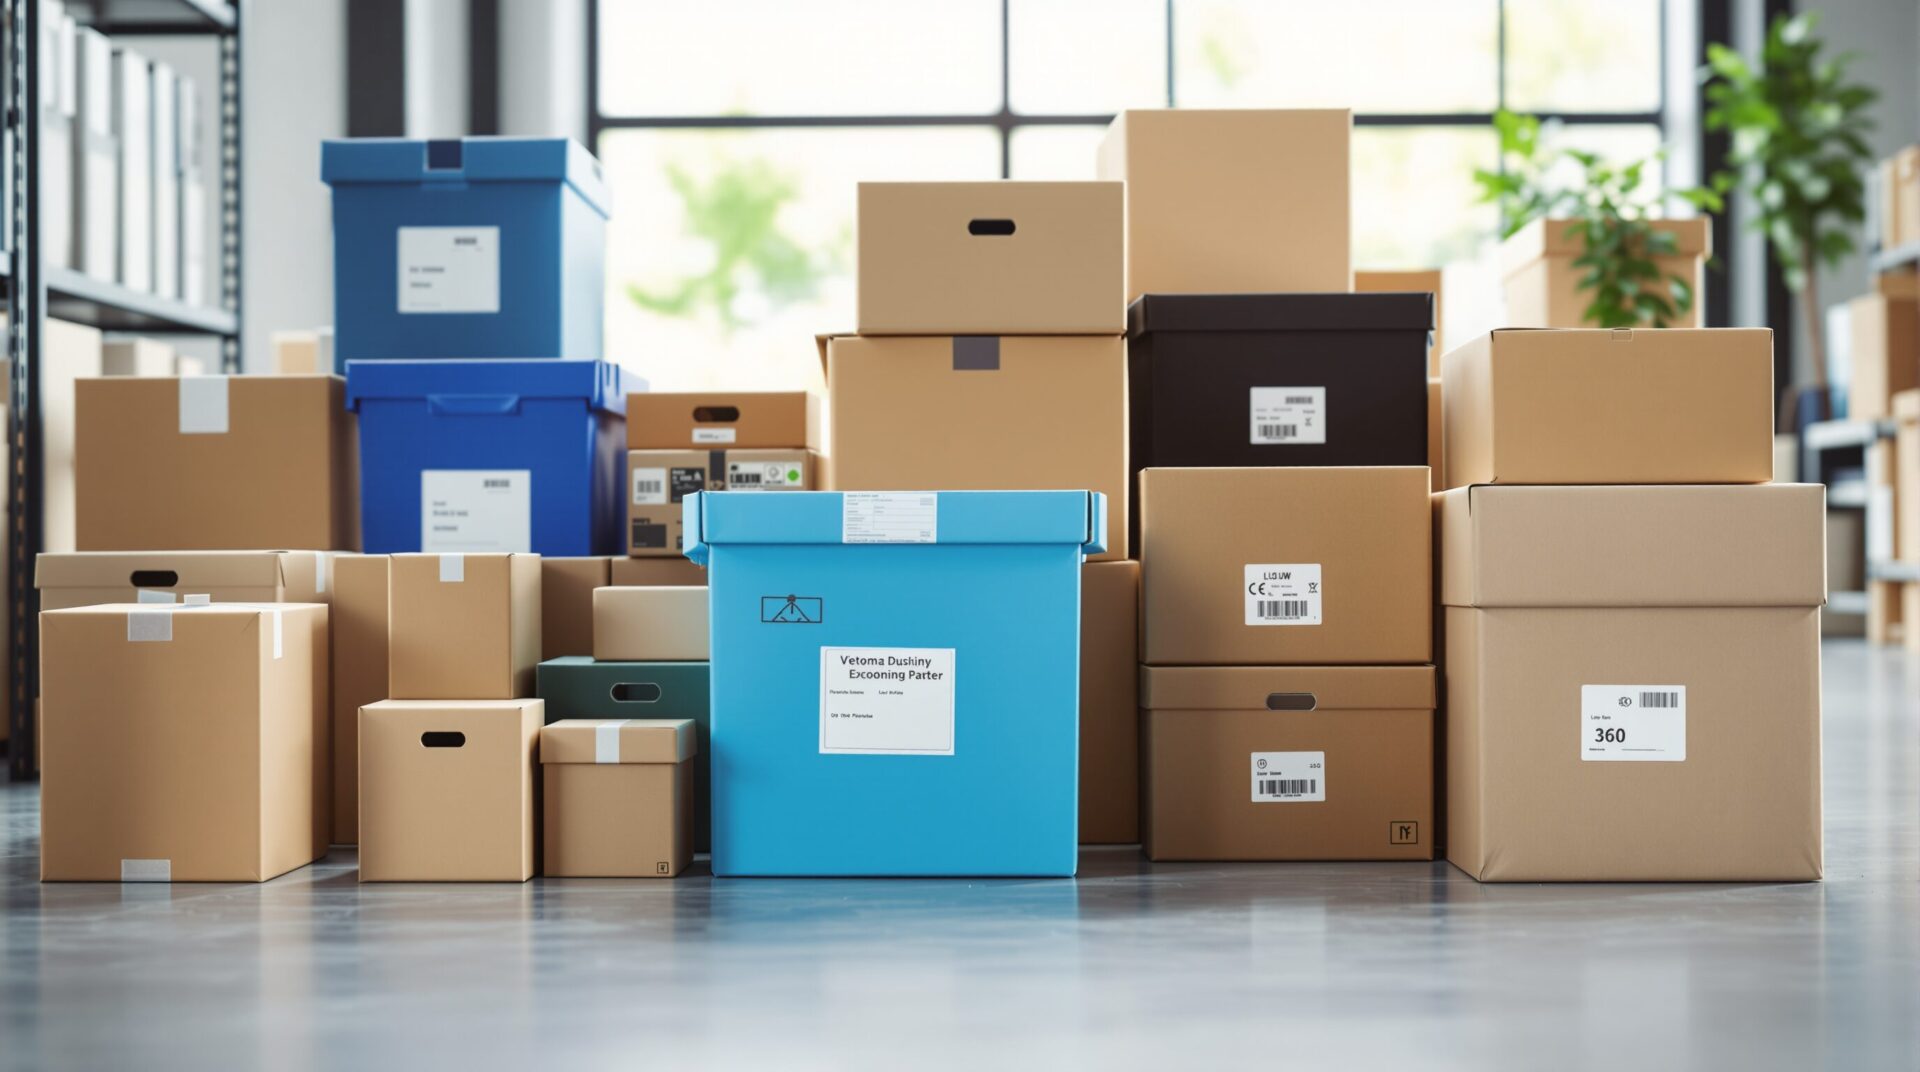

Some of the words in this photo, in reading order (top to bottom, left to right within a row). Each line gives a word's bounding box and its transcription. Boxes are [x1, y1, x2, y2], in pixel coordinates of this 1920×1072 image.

[840, 655, 885, 666] Vetoma
[908, 670, 944, 680] Parter
[1594, 727, 1626, 743] 360
